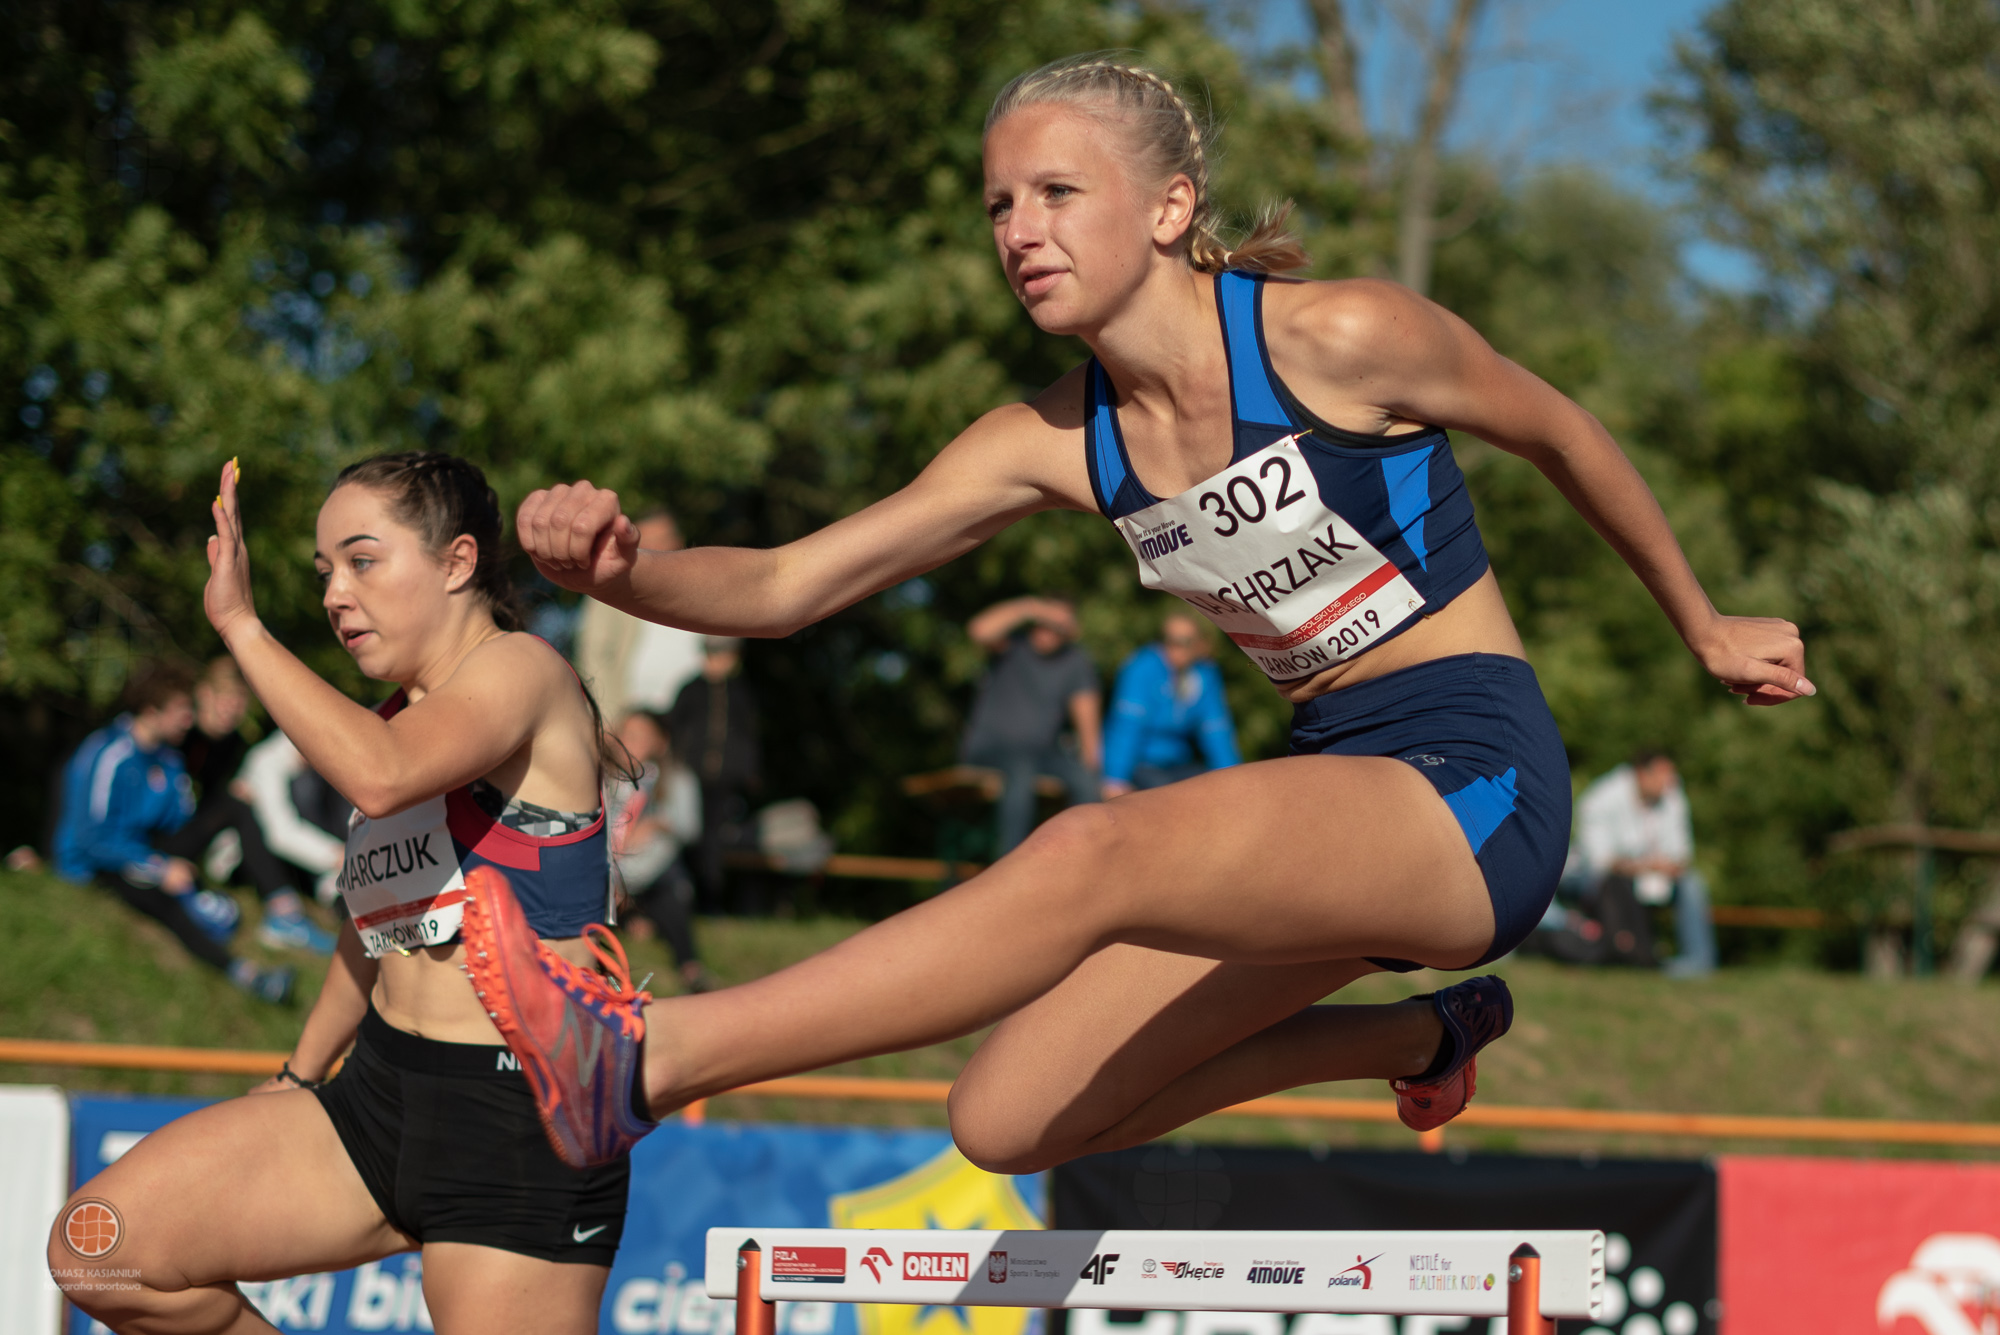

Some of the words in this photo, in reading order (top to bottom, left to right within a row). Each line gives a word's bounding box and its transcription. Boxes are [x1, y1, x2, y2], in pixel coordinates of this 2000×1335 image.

[1199, 456, 1306, 537] 302
[1161, 519, 1176, 530] Move
[1300, 610, 1328, 633] POLSKI
[1327, 600, 1342, 613] U16
[1309, 592, 1367, 637] KUSOCIŃSKIEGO
[1258, 645, 1329, 675] TARNÓW
[1327, 609, 1380, 656] 2019
[336, 833, 439, 891] MARCZUK
[905, 1255, 966, 1278] ORLEN
[1246, 1267, 1306, 1284] 4MOVE
[1441, 1258, 1452, 1271] for
[1327, 1275, 1362, 1288] polanik
[1409, 1274, 1458, 1291] HEALTHIER
[1461, 1274, 1481, 1291] KIDS
